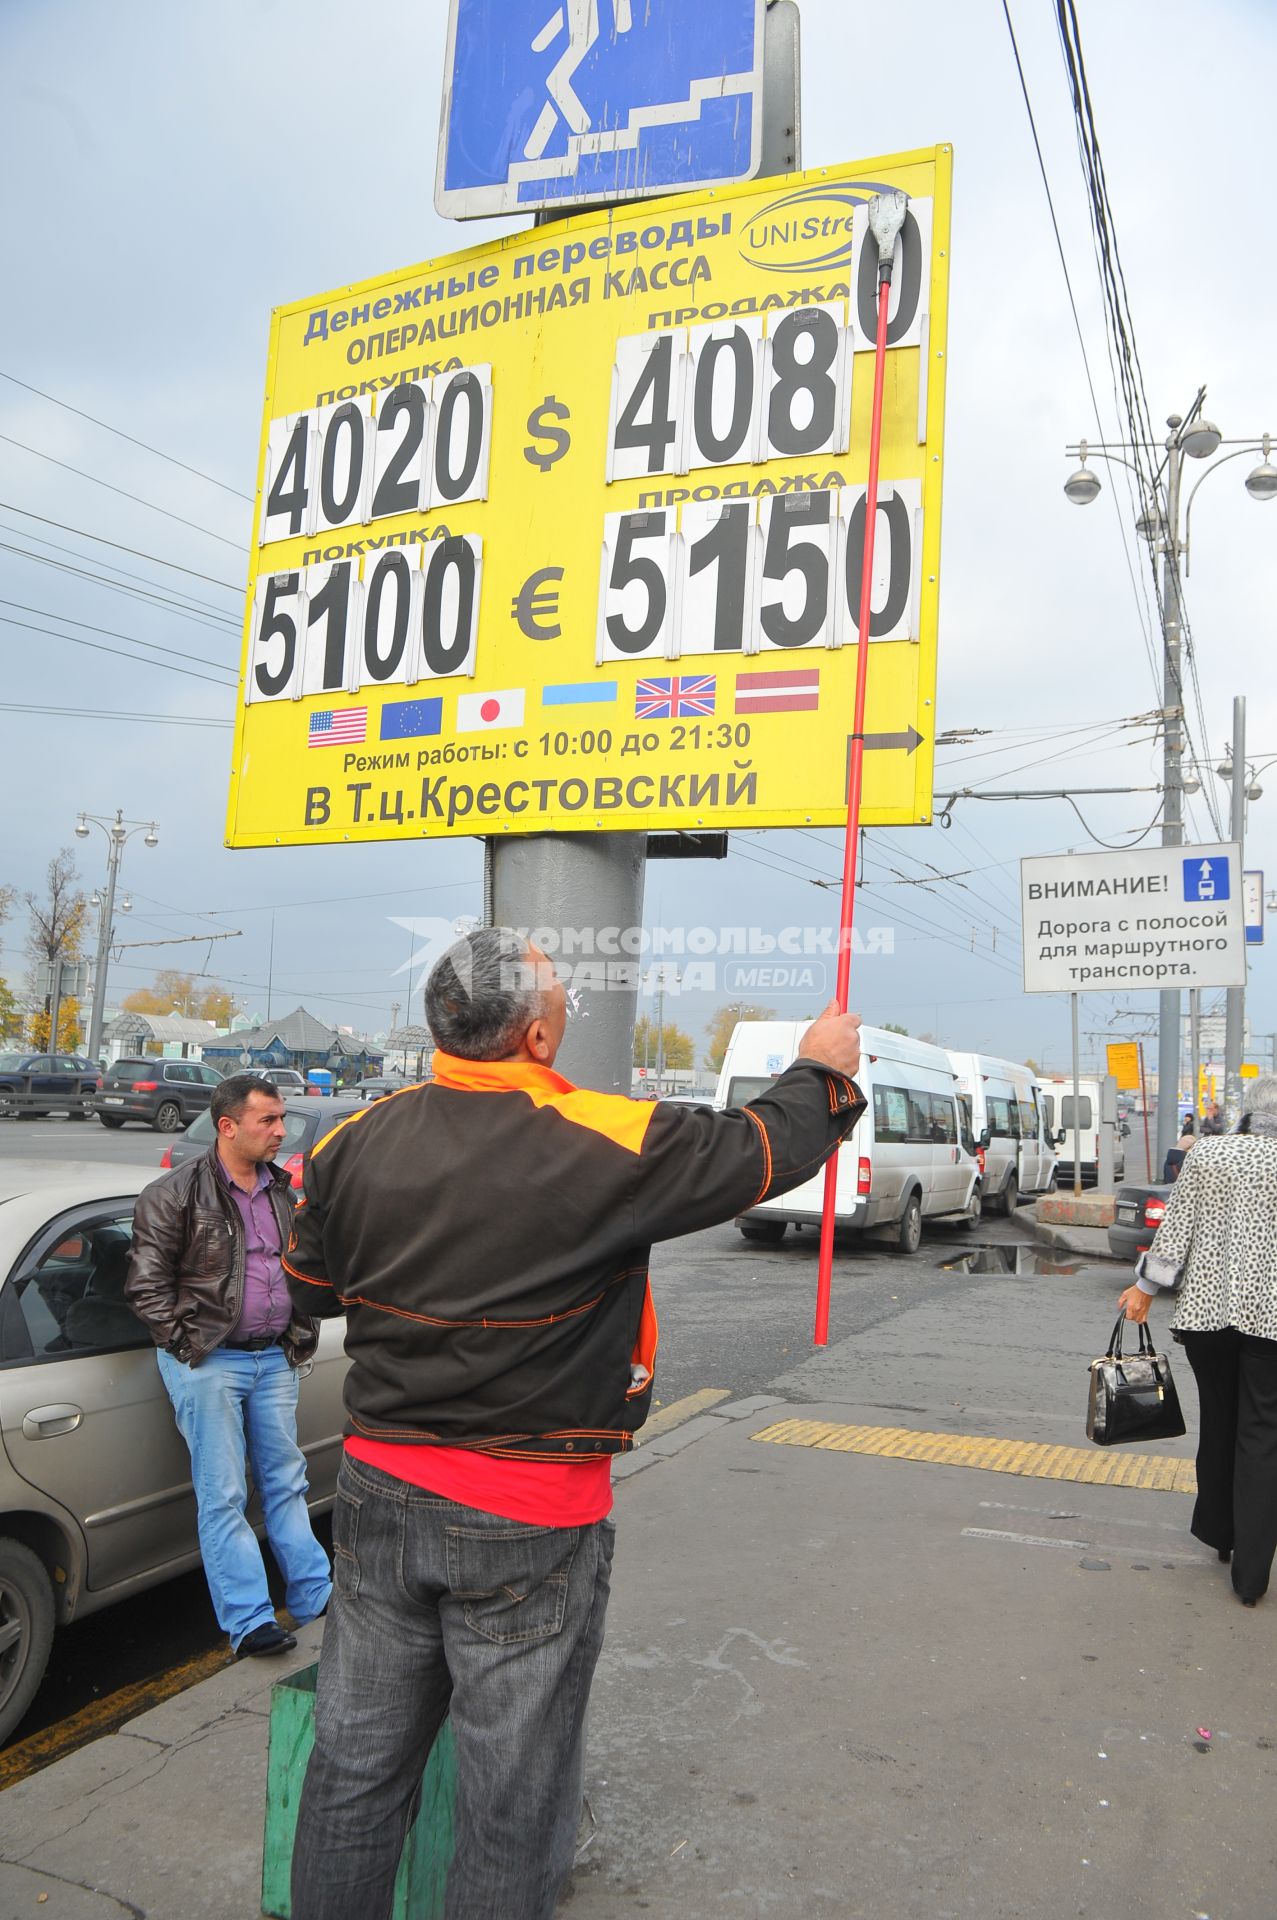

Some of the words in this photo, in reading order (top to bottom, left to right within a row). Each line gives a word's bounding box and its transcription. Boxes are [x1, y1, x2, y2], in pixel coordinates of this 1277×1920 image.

[303, 265, 500, 346] Денежные
[513, 213, 732, 279] переводы
[346, 276, 591, 365] ОПЕРАЦИОННАЯ
[603, 255, 712, 300] КАССА
[648, 282, 850, 329] ПРОДАЖА
[316, 356, 464, 407] ПОКУПКА
[266, 371, 484, 535] 4020
[638, 471, 847, 509] ПРОДАЖА
[303, 524, 452, 566] ПОКУПКА
[606, 488, 911, 654] 5150
[255, 536, 476, 696] 5100
[343, 750, 410, 773] Режим
[416, 740, 507, 771] работы:
[513, 739, 529, 758] с
[539, 729, 612, 756] 10:00
[621, 729, 660, 756] до
[670, 722, 751, 751] 21:30
[304, 786, 331, 826] В
[1028, 875, 1169, 900] ВНИМАНИЕ!
[1038, 919, 1111, 938] Дорога
[1118, 919, 1129, 932] с
[1136, 911, 1228, 931] полосой
[1039, 945, 1077, 960] для
[1085, 938, 1228, 957] маршрутного
[1069, 963, 1197, 982] транспорта.
